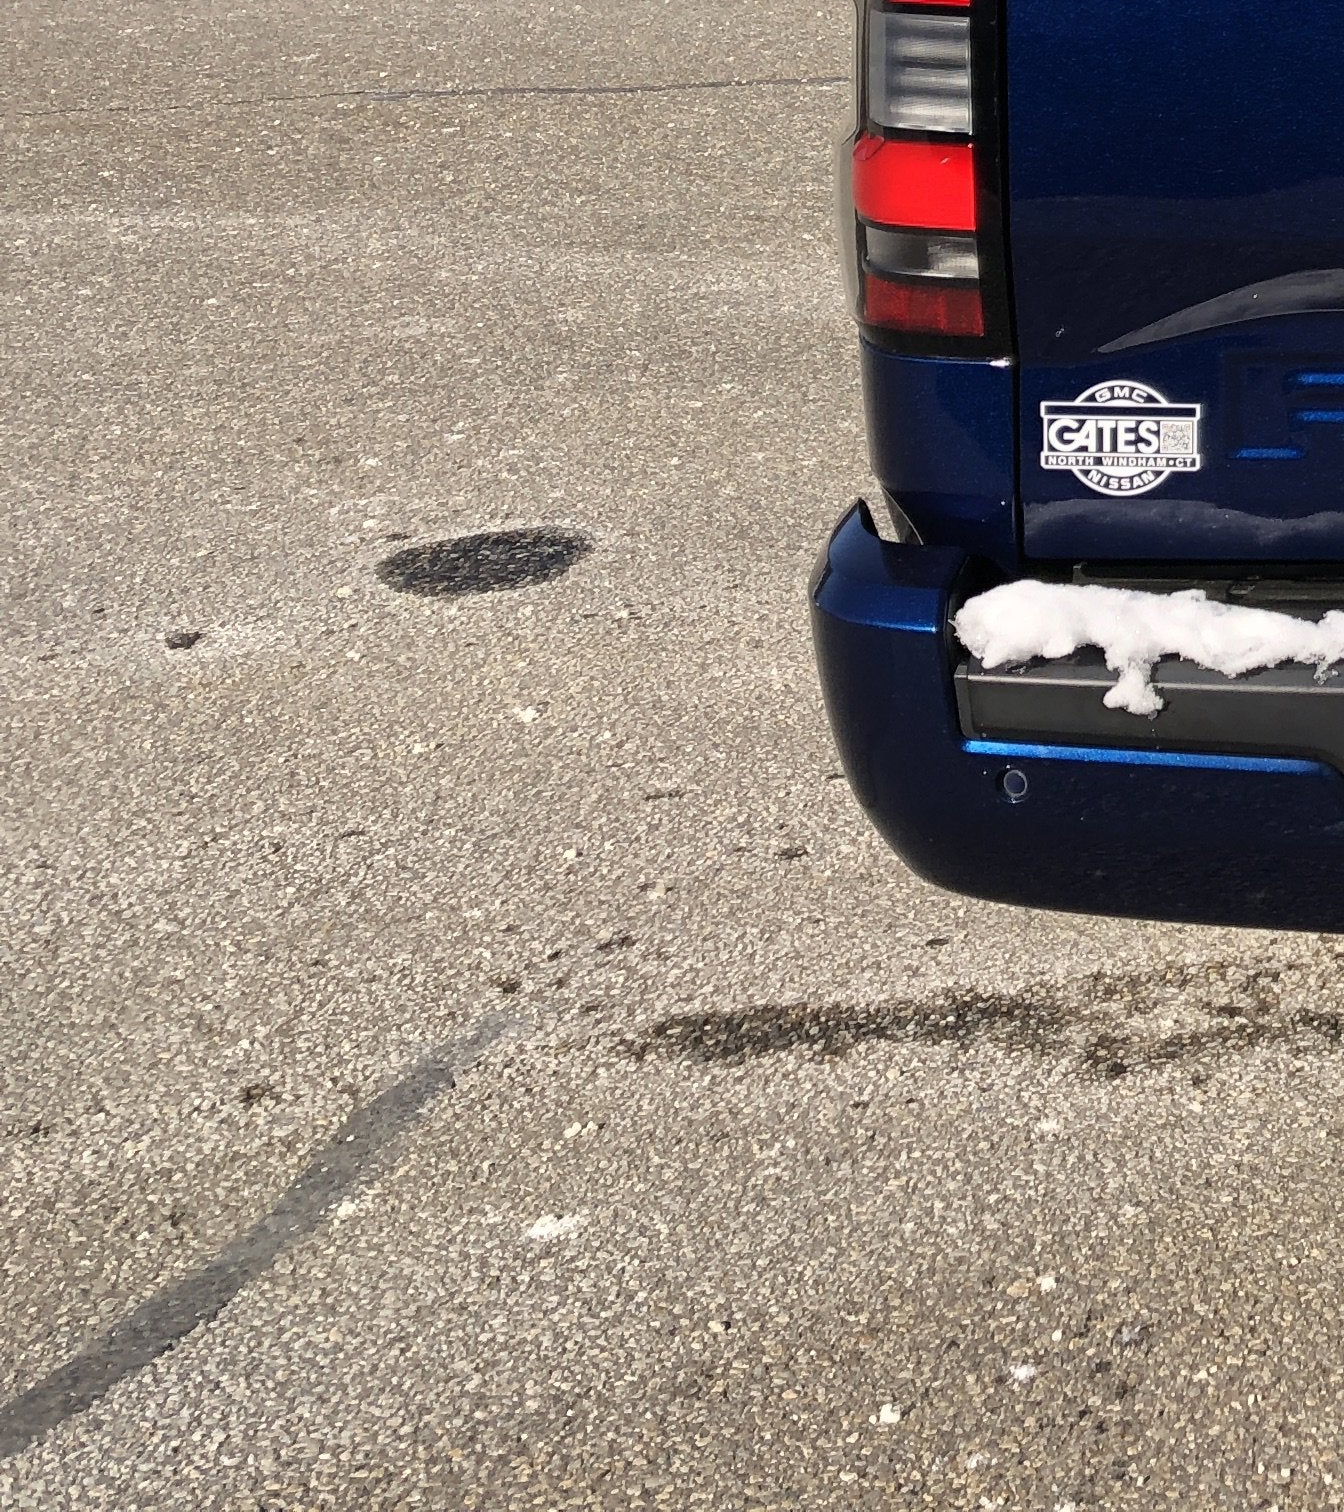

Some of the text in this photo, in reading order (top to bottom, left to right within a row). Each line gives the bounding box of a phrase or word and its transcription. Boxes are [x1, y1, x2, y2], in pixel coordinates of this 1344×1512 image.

[1094, 386, 1148, 403] GMC
[1048, 418, 1160, 453] GATES
[1049, 456, 1094, 466] NORTH
[1087, 470, 1155, 489] NISSAN
